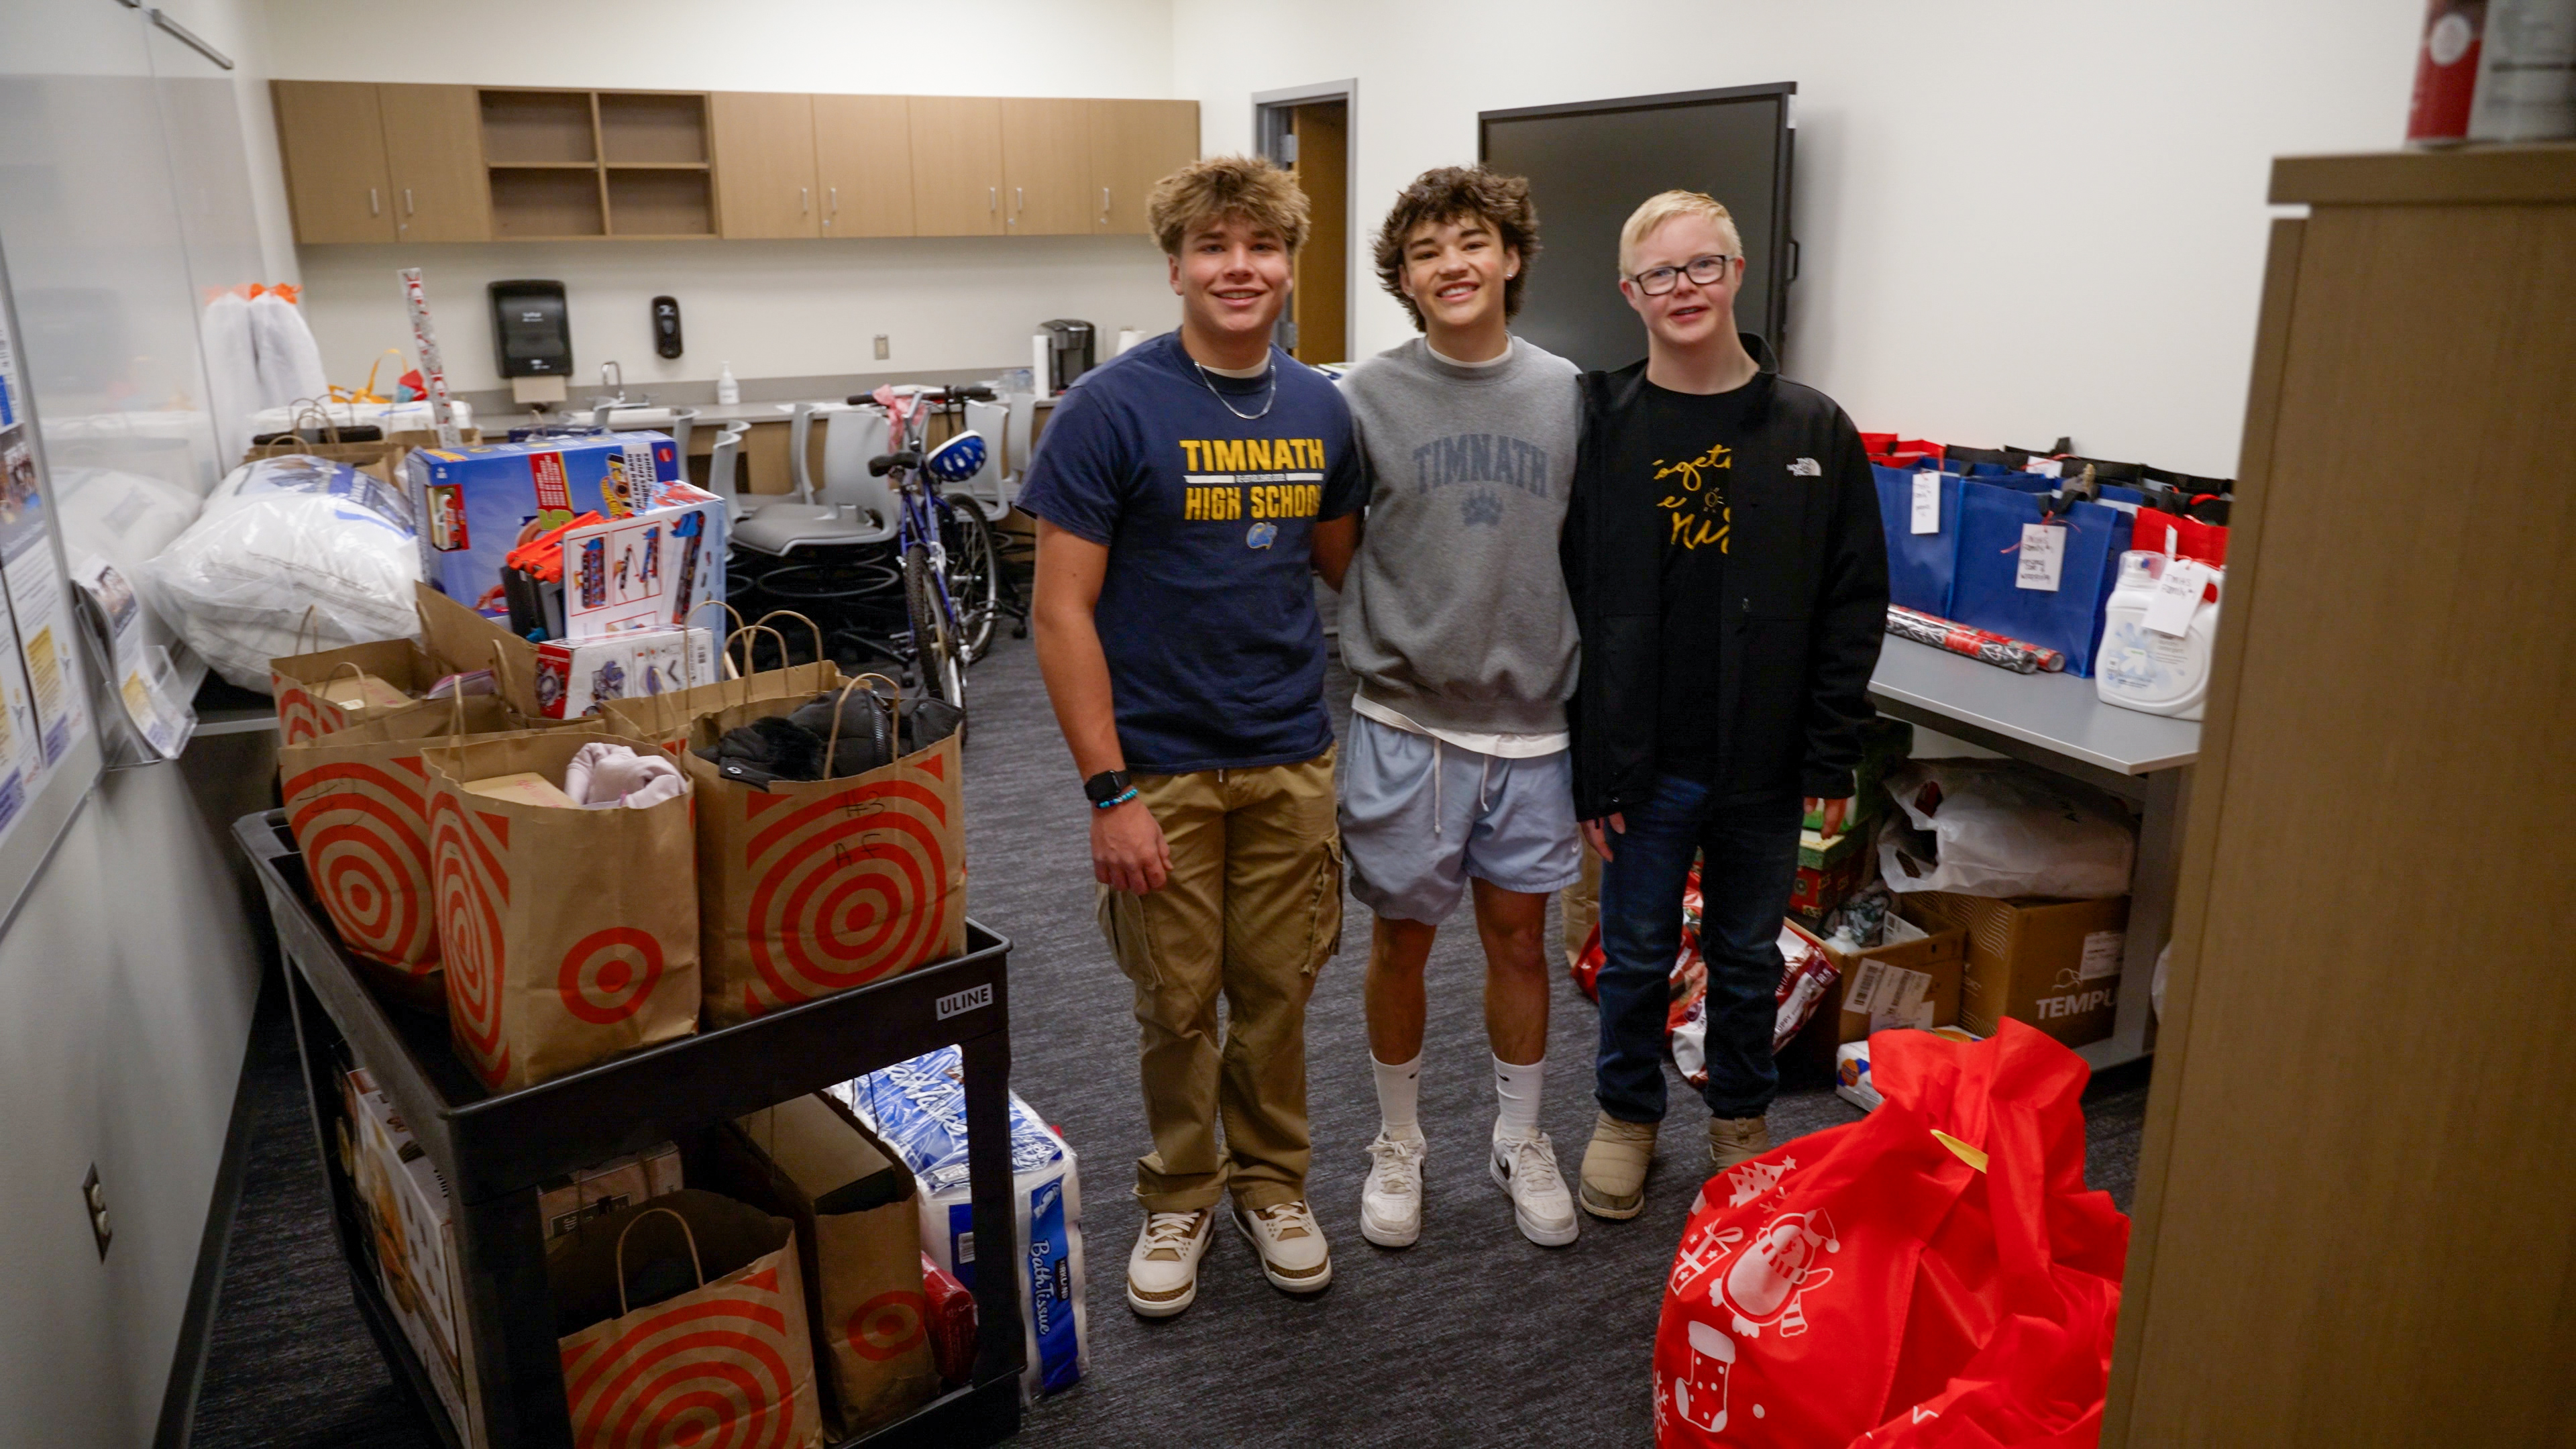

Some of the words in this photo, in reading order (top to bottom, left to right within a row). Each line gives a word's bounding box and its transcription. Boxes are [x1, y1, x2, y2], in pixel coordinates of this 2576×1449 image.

[1179, 438, 1326, 472] TIMNATH
[1412, 433, 1548, 498] TIMNATH
[1184, 486, 1242, 521] HIGH
[835, 790, 885, 822] #3
[941, 988, 990, 1014] ULINE
[1030, 1240, 1054, 1286] Bath
[1034, 1280, 1055, 1336] Tissue
